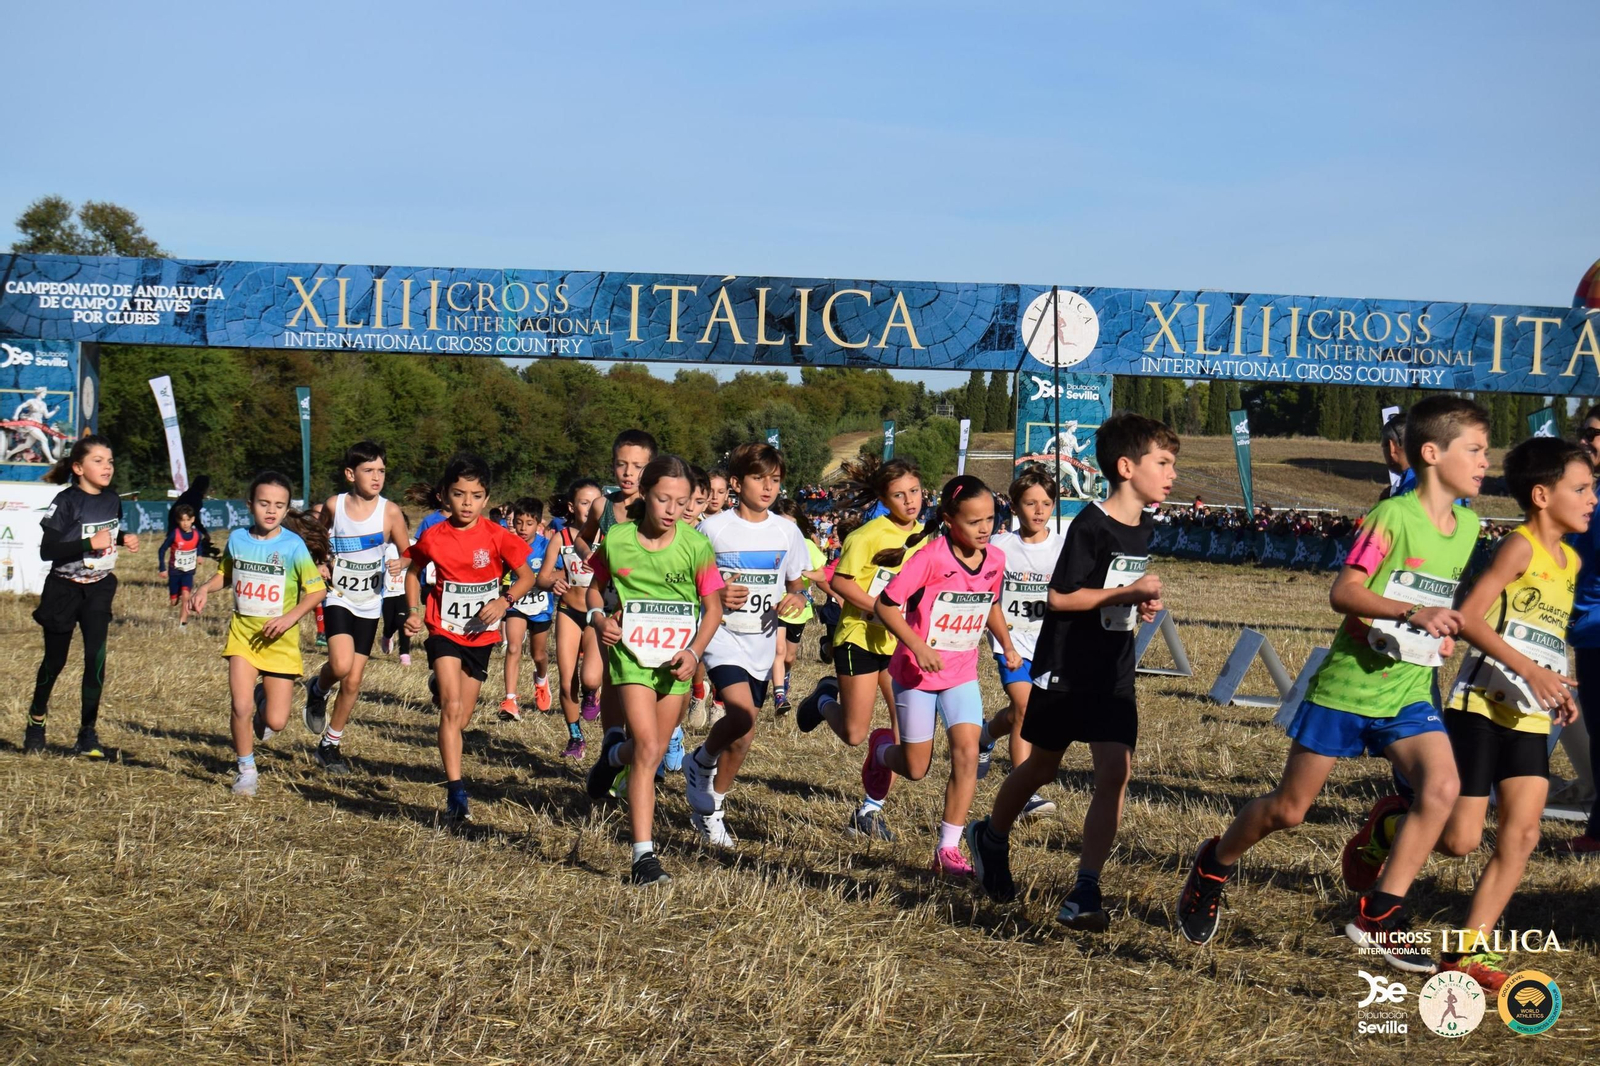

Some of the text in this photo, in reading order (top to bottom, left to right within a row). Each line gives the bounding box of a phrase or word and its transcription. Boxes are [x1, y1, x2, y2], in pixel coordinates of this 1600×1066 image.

[5, 281, 225, 300] CAMPEONATO DE ANDALUCÍA
[446, 281, 570, 314] CROSS
[39, 296, 191, 313] DE CAMPO A TRAVÉS
[284, 276, 442, 331] XLIII
[626, 275, 926, 350] ITÁLICA
[73, 310, 160, 326] POR CLUBES
[446, 315, 614, 336] INTERNACIONAL
[1307, 309, 1431, 345] CROSS
[1143, 301, 1304, 359] XLIII
[284, 331, 584, 355] INTERNATIONAL CROSS COUNTRY
[35, 357, 68, 367] Sevilla
[1307, 343, 1476, 367] INTERNACIONAL
[1141, 357, 1446, 386] INTERNATIONAL CROSS COUNTRY
[1066, 390, 1099, 400] Sevilla
[235, 580, 280, 602] 4446
[337, 575, 380, 592] 4210
[460, 584, 489, 593] ITÁLICA
[447, 598, 496, 619] 412
[645, 602, 680, 613] ITÁLICA
[935, 613, 984, 634] 4444
[629, 625, 692, 649] 4427
